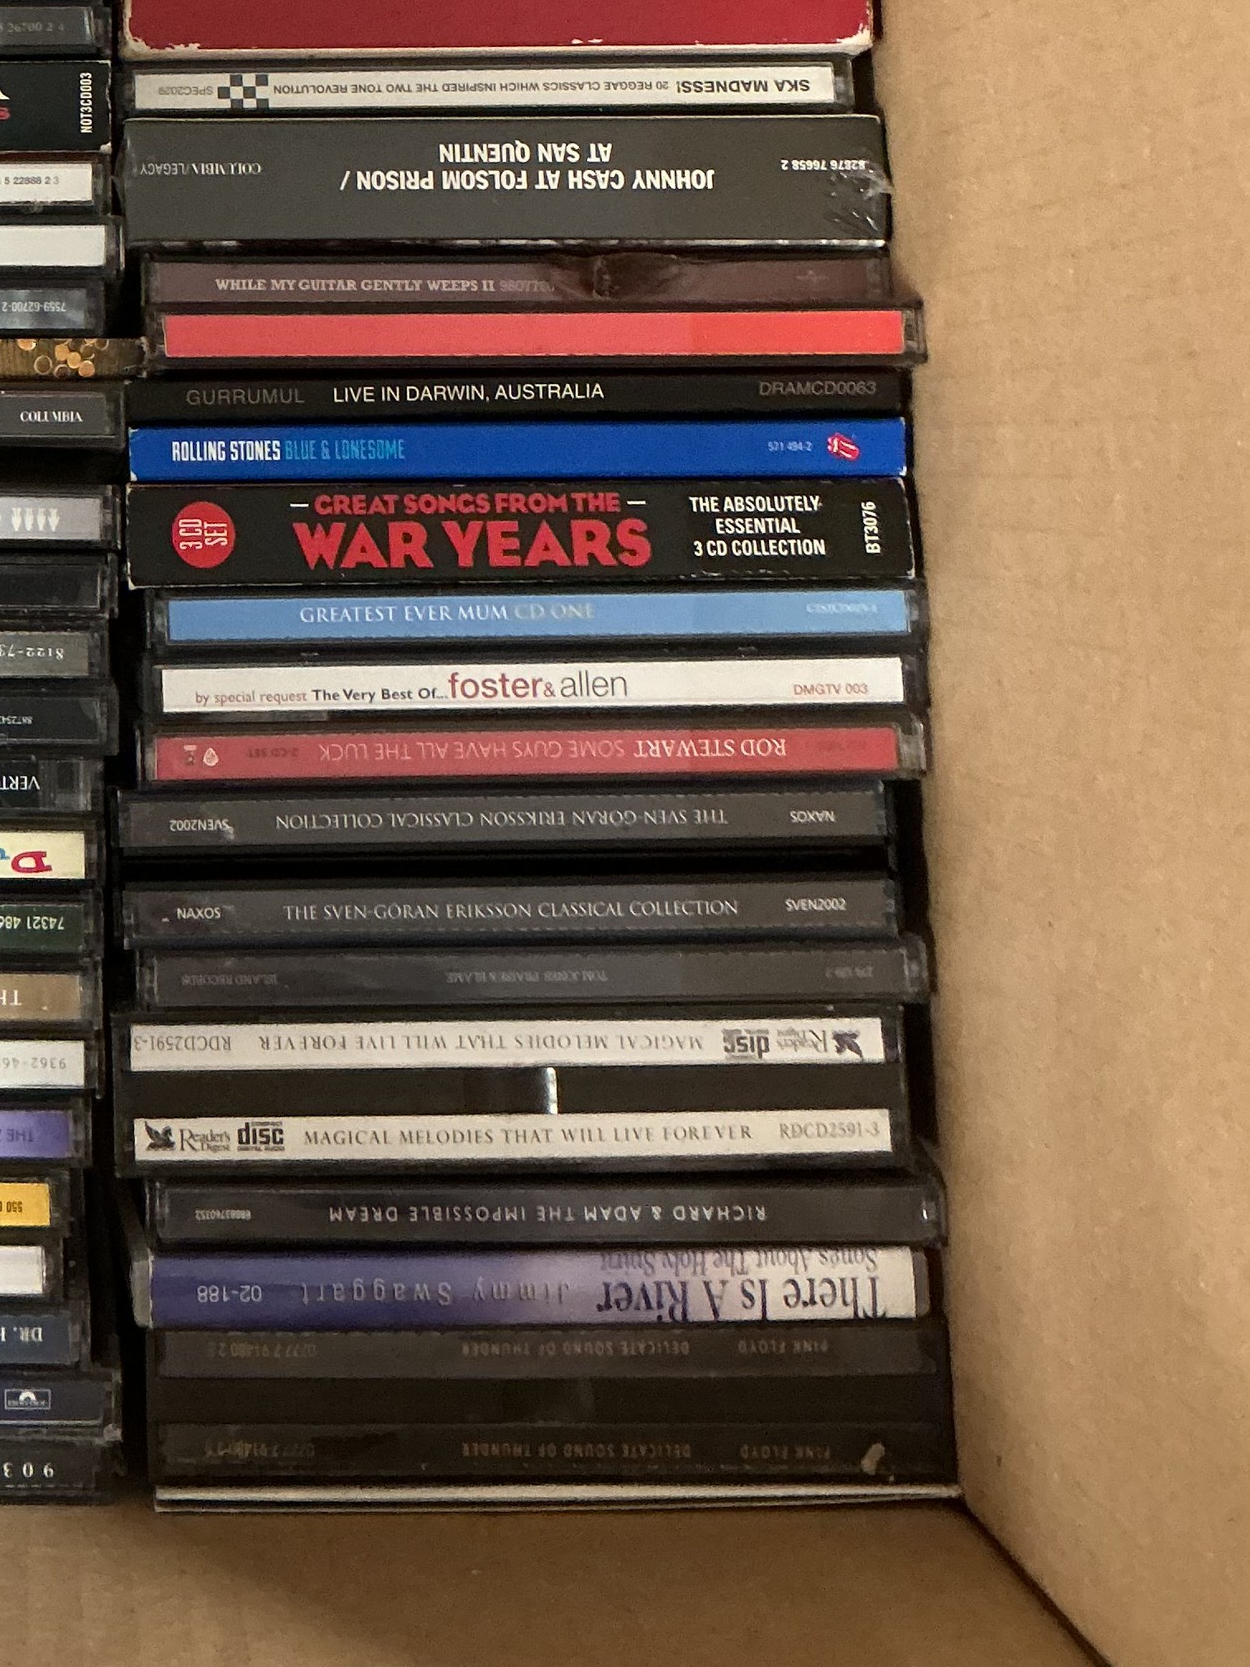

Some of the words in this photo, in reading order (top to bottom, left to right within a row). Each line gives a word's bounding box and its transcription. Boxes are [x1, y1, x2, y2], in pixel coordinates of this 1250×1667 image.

[677, 80, 768, 93] MADNESS!
[780, 80, 809, 92] SKA
[80, 73, 92, 133] NOT3CD003
[440, 140, 530, 162] QUENTIN
[538, 143, 579, 162] SAN
[587, 143, 612, 162] AT
[357, 171, 433, 190] PRISON
[442, 170, 527, 190] FOLSOM
[535, 170, 560, 189] AT
[563, 170, 624, 189] CASH
[632, 170, 714, 189] JOHNNY
[215, 279, 266, 290] WHILE
[271, 279, 296, 290] MY
[298, 279, 357, 290] GUITAR
[361, 280, 422, 291] GENTLY
[427, 280, 478, 291] WEEPS
[334, 387, 375, 402] LIVE
[382, 387, 399, 401] IN
[407, 385, 489, 401] DARWIN,
[495, 383, 604, 399] AUSTRALIA
[20, 411, 82, 422] COLUMBIA
[172, 441, 225, 461] ROLLING
[230, 441, 280, 460] STONES
[315, 495, 399, 514] GREAT
[404, 493, 490, 514] SONGS
[495, 493, 567, 513] FROM
[571, 493, 620, 512] THE
[689, 497, 719, 512] THE
[729, 496, 822, 512] ABSOLUTELY
[716, 518, 800, 534] ESSENTIAL
[861, 502, 881, 553] BT3076
[293, 521, 433, 569] WAR
[442, 518, 651, 567] YEARS
[694, 541, 703, 556] 3
[707, 541, 727, 556] CD
[732, 539, 825, 556] COLLECTION
[794, 684, 840, 695] DMGTV
[846, 683, 868, 694] 003
[177, 907, 220, 919] NAXOS
[786, 898, 846, 911] SVEN2002
[197, 1285, 262, 1302] 02-188
